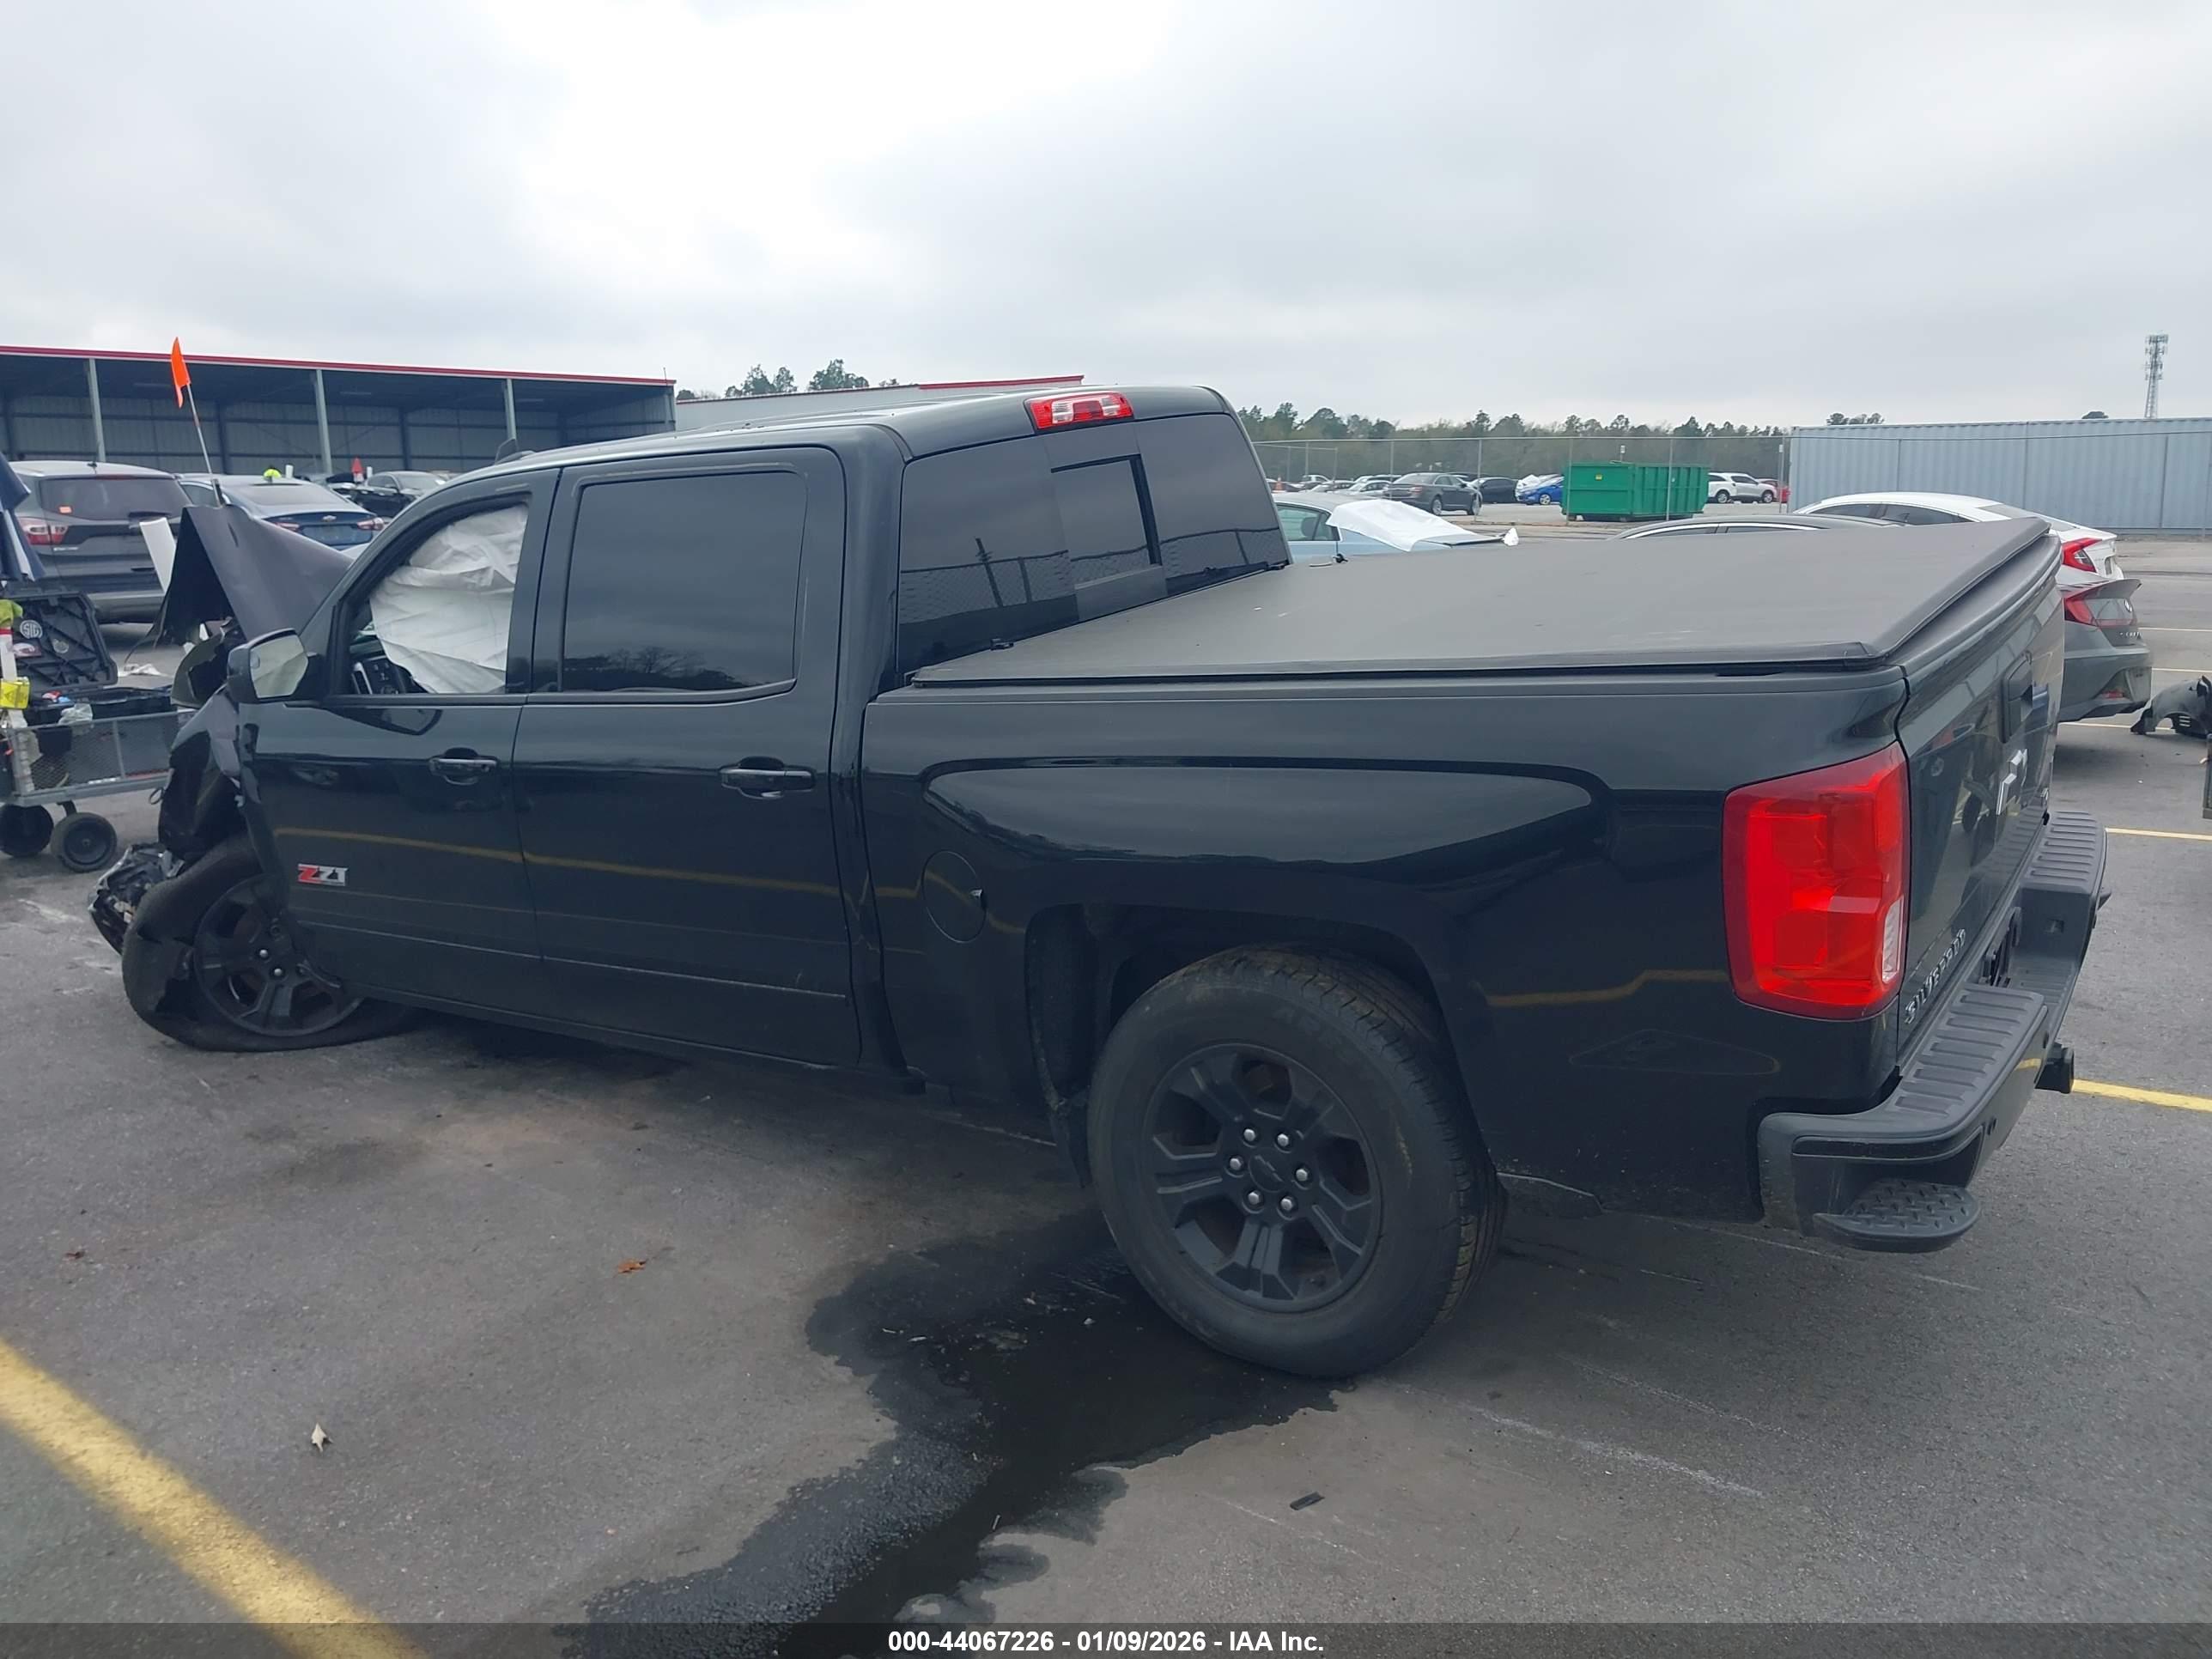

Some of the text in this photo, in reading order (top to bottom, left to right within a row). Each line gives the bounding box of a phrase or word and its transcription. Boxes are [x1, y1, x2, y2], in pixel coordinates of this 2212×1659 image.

[22, 621, 41, 638] SIG
[297, 863, 349, 887] Z71
[1904, 928, 1966, 1024] SILVERADO
